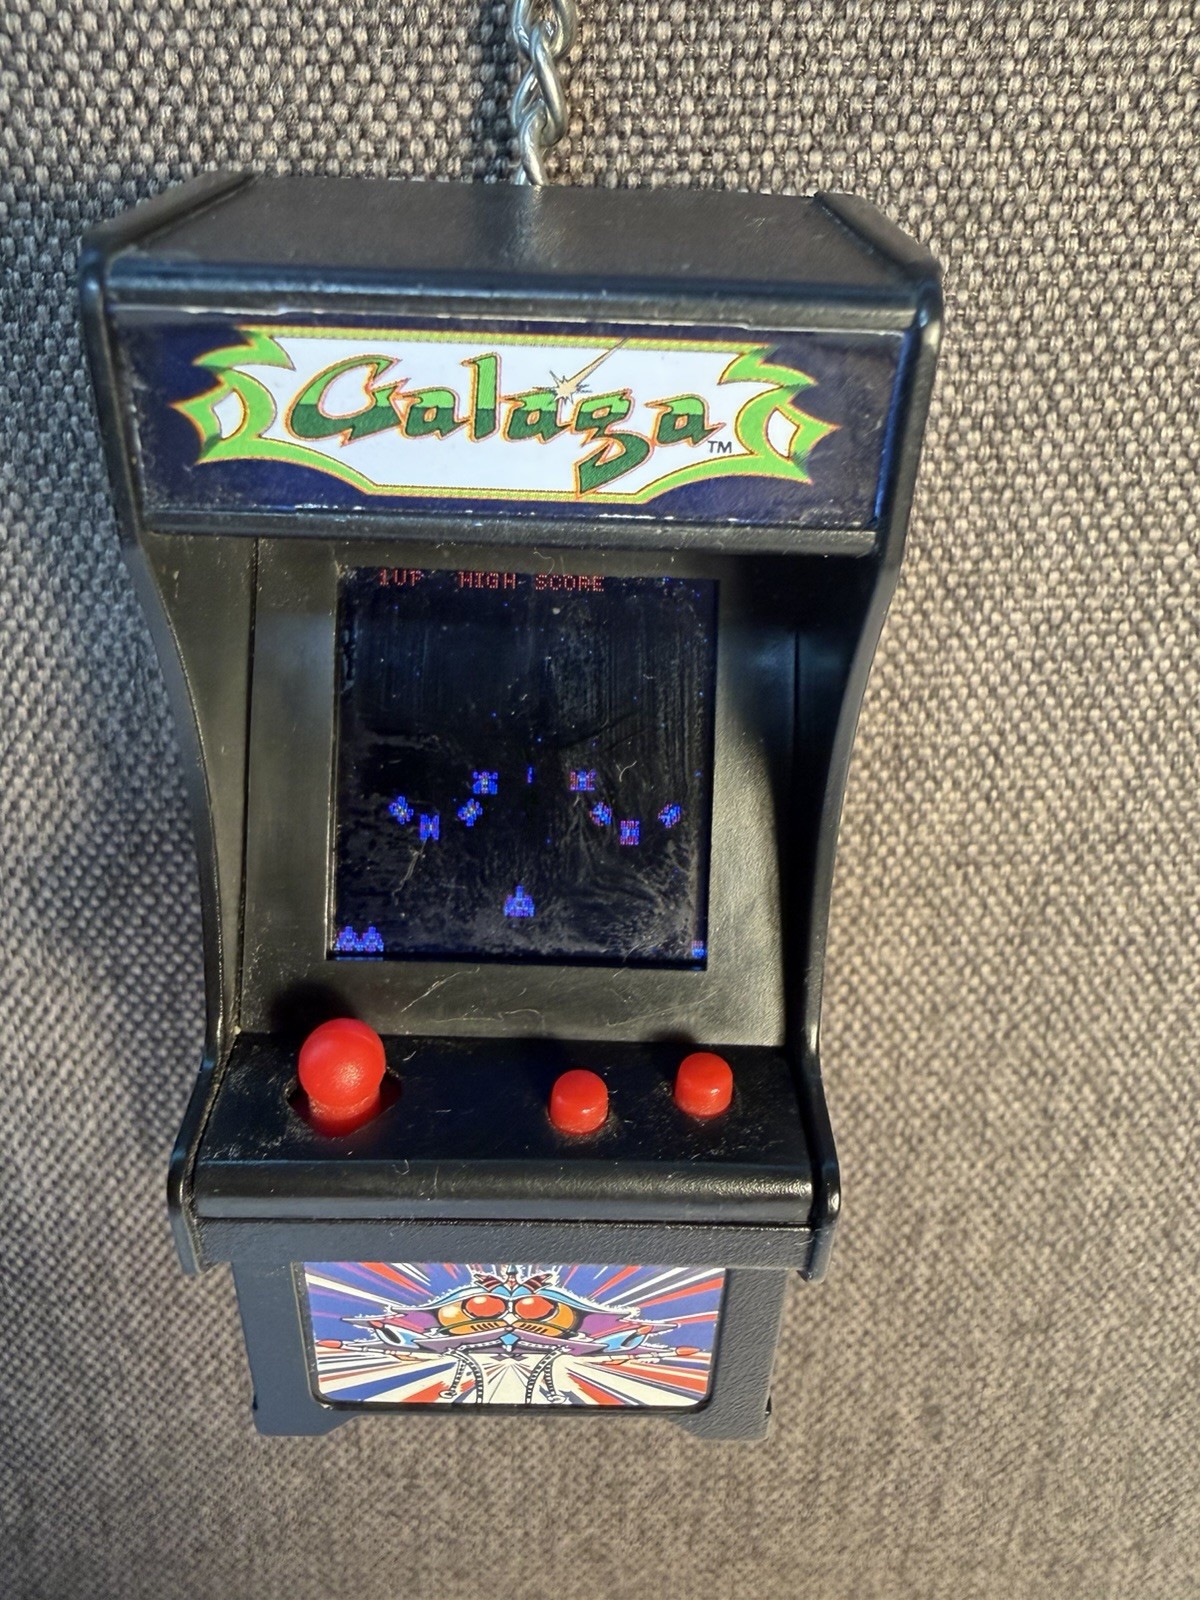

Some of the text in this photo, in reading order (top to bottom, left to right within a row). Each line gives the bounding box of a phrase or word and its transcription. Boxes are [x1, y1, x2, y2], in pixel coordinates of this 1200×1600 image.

[287, 353, 733, 496] Galaga TM
[379, 569, 605, 592] 1UP HIGH SCORE
